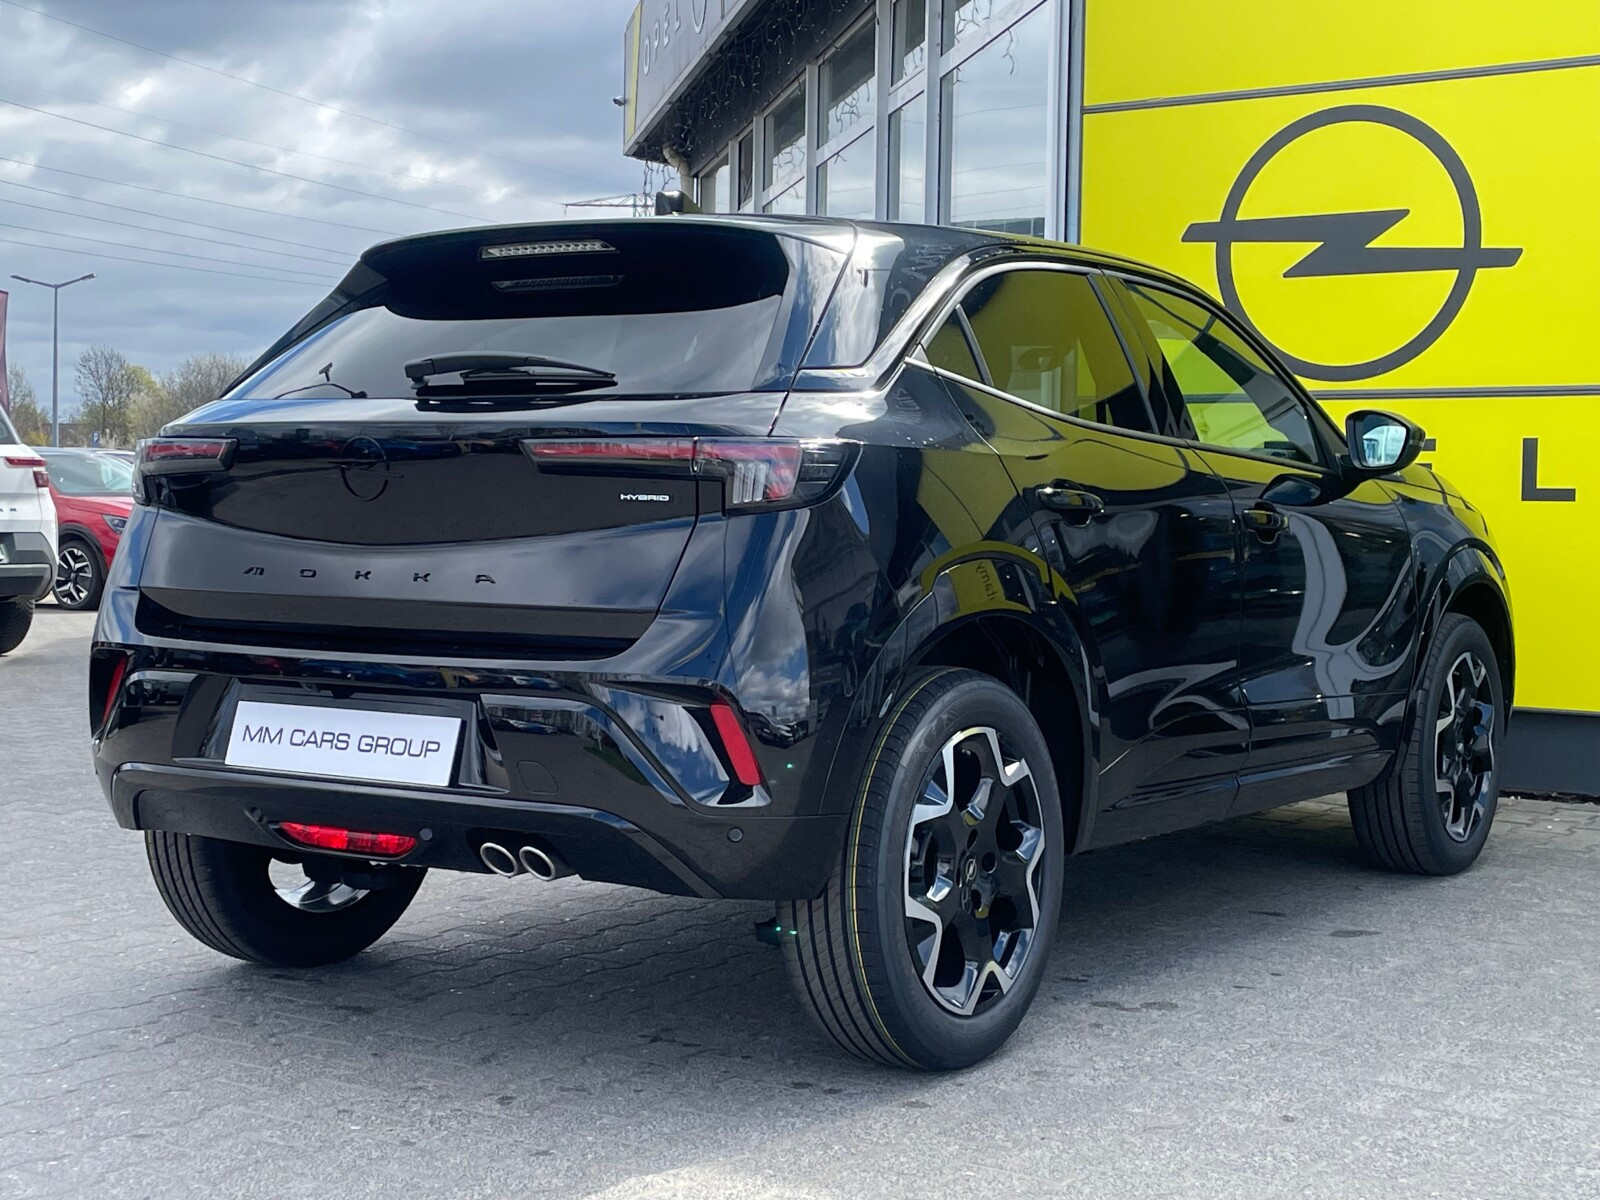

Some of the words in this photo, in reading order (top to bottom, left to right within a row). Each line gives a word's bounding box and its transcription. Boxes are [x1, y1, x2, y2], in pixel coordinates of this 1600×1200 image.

[643, 0, 681, 76] OPEL
[620, 493, 670, 502] HYBRID
[242, 566, 496, 585] MOKKA
[242, 724, 284, 745] MM
[289, 728, 351, 751] CARS
[357, 734, 441, 758] GROUP
